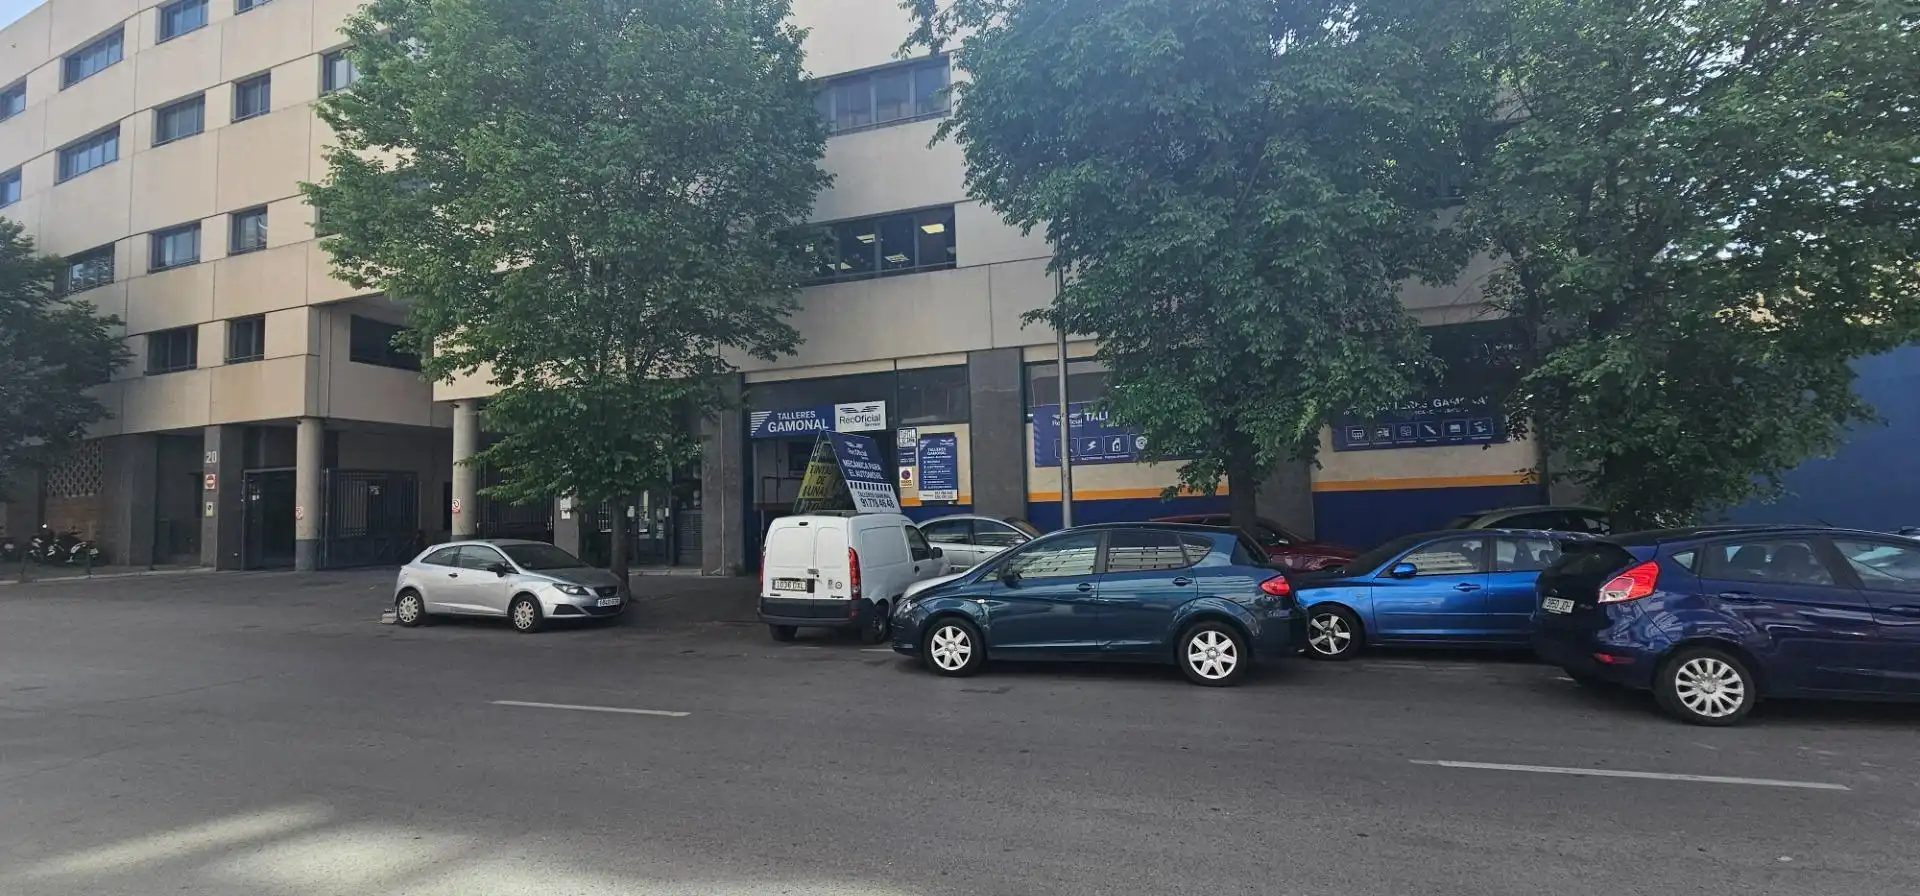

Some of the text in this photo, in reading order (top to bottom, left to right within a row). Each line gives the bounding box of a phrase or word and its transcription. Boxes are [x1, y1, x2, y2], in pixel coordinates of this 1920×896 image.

[777, 411, 816, 420] TALLERES
[839, 413, 881, 424] RecOficial
[768, 418, 829, 433] GAMONAL
[205, 450, 217, 464] 20
